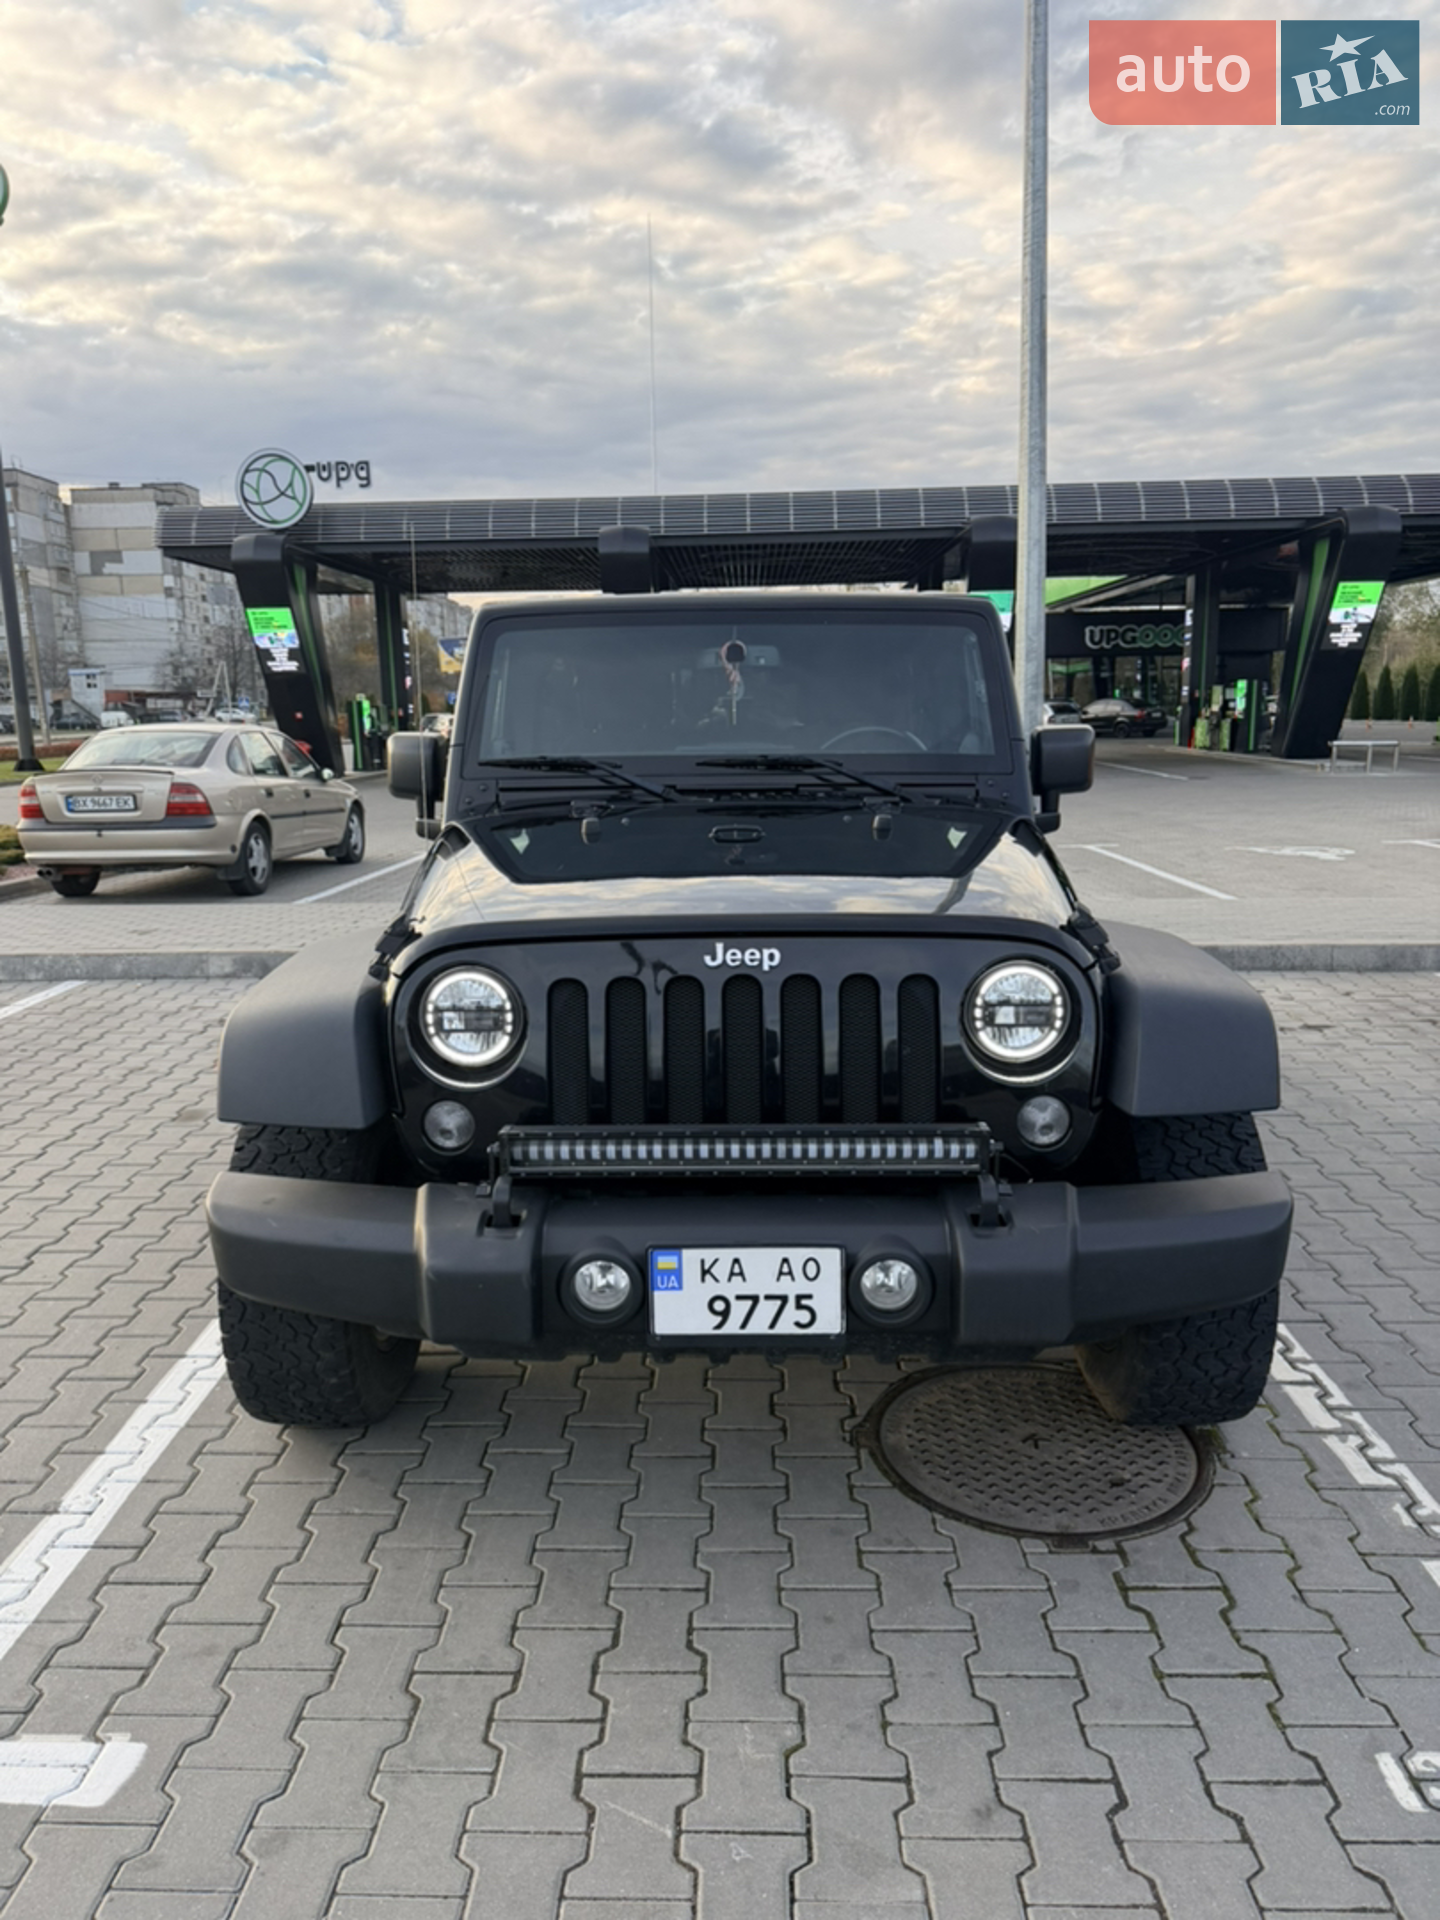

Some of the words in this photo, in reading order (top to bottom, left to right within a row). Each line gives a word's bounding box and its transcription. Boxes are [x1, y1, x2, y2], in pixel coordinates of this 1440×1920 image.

[316, 460, 371, 488] upg
[703, 942, 781, 971] Jeep
[656, 1275, 679, 1289] UA
[700, 1257, 747, 1284] KA
[776, 1256, 821, 1282] AO
[707, 1293, 818, 1330] 9775
